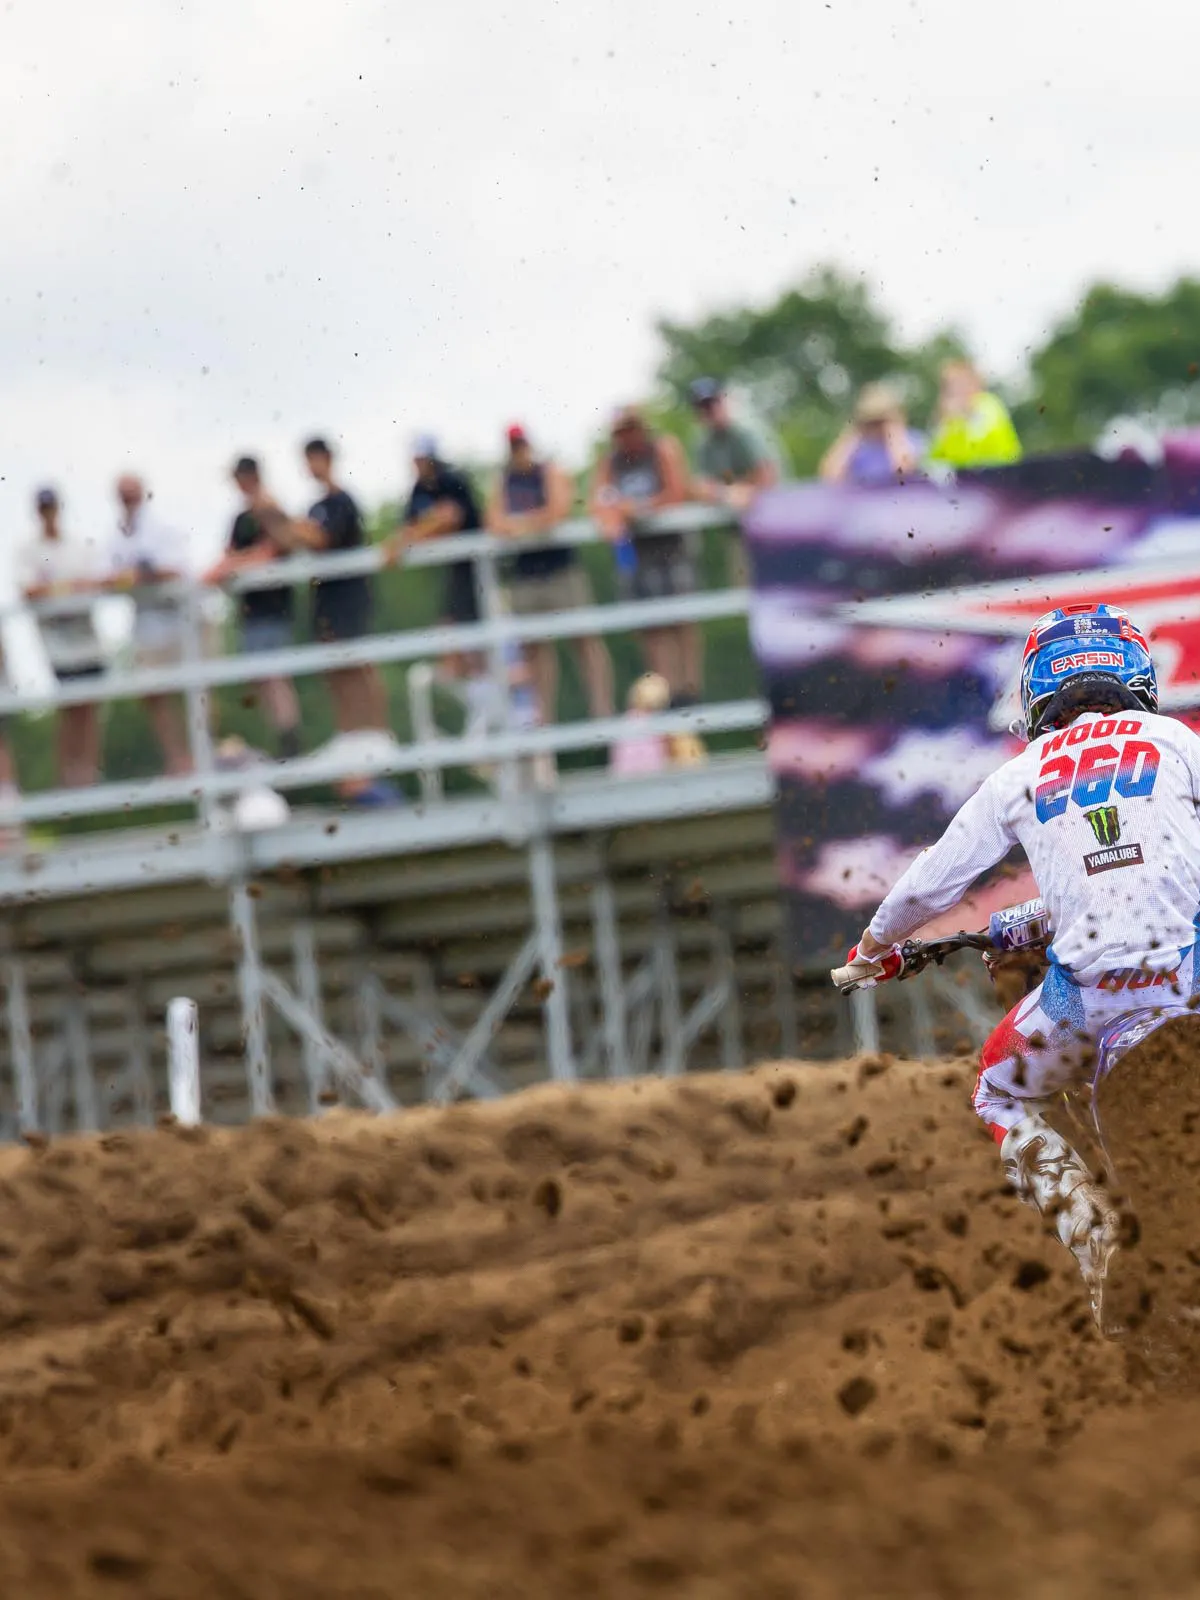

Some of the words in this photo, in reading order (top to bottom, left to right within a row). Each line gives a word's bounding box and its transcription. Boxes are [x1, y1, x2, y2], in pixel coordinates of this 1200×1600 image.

[1051, 651, 1125, 674] CARSON
[1040, 719, 1143, 761] WOOD
[1035, 740, 1160, 825] 260
[1088, 846, 1139, 868] YAMALUBE
